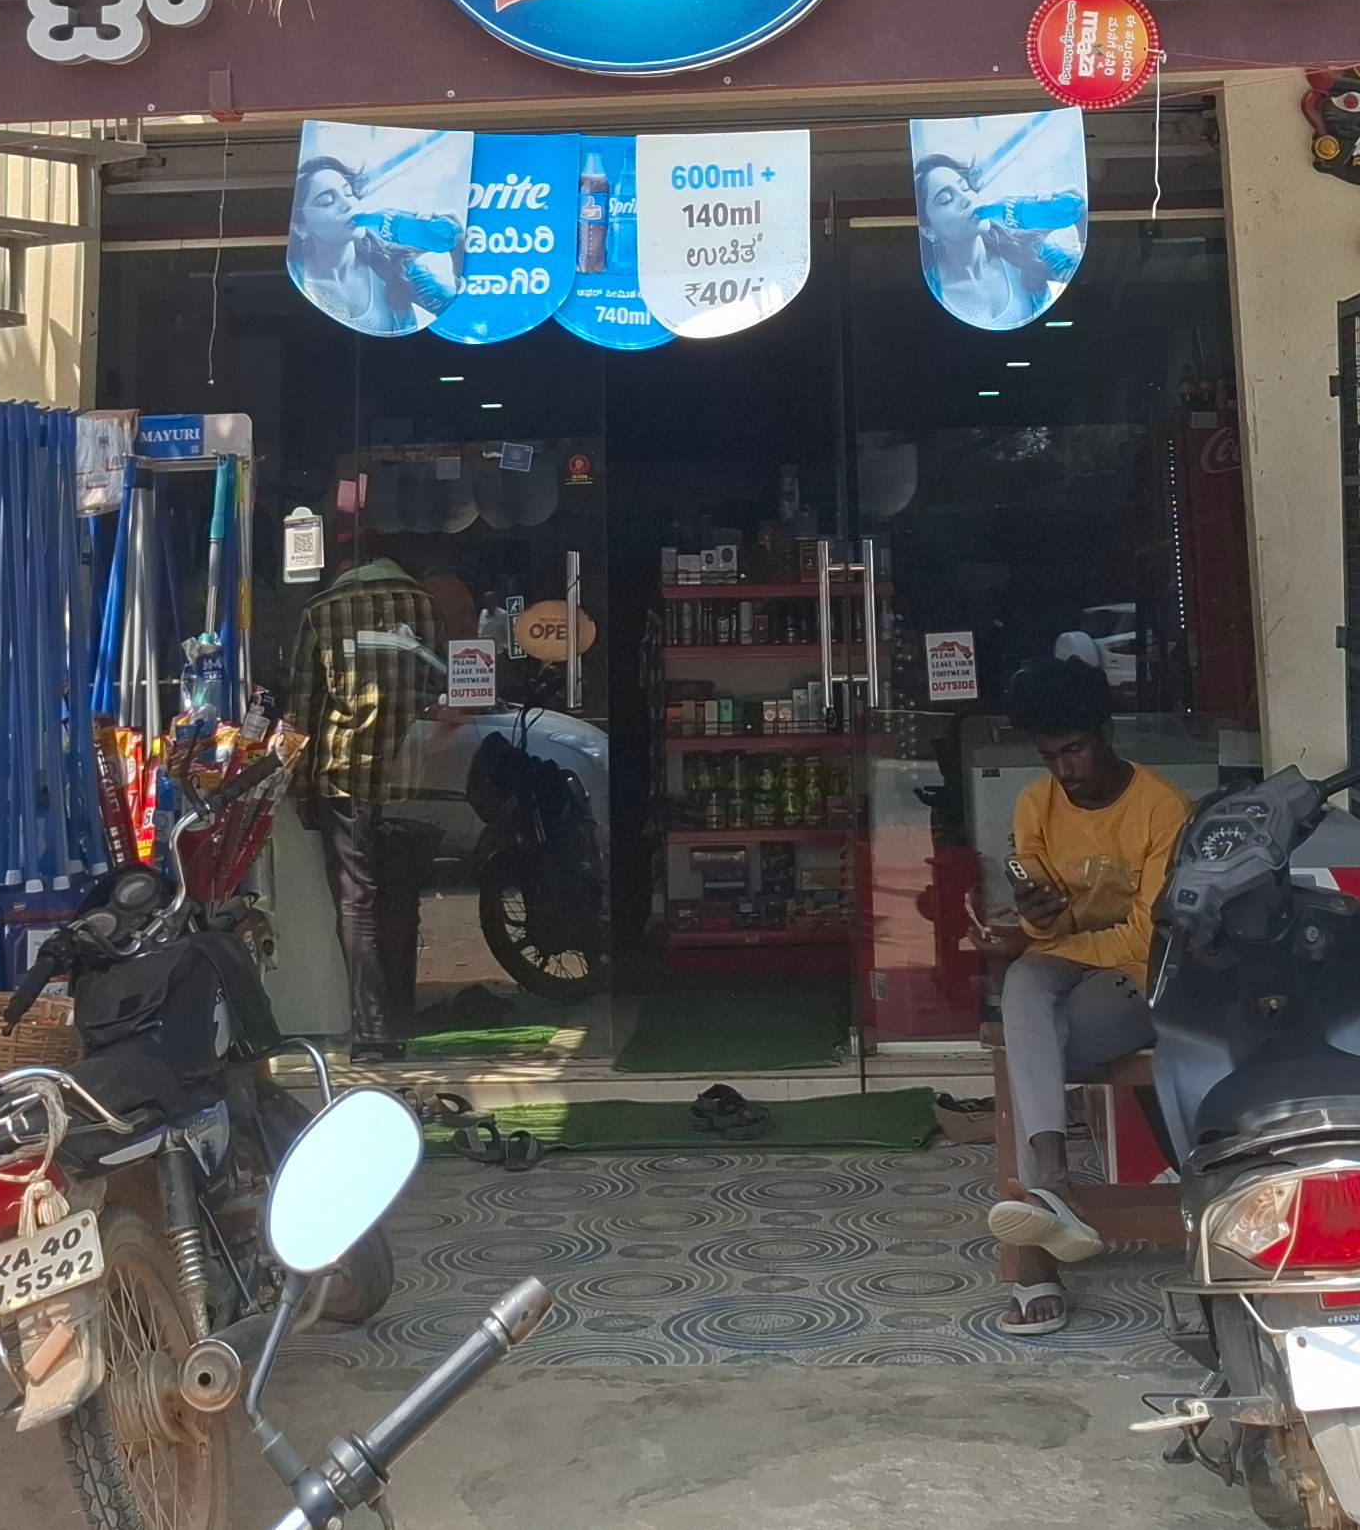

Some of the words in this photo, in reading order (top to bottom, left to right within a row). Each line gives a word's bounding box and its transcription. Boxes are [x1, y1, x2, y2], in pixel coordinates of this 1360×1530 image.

[1077, 11, 1099, 77] maaza
[671, 163, 753, 190] 600ml
[761, 166, 776, 182] +
[467, 173, 552, 210] prite
[682, 200, 761, 228] 140ml
[464, 225, 555, 254] ಡಿಯಿರಿ
[595, 306, 651, 326] 740ml
[141, 427, 201, 443] MAYURI
[529, 622, 571, 640] OPE
[451, 687, 494, 699] OUTSIDE
[931, 680, 975, 692] OUTSIDE
